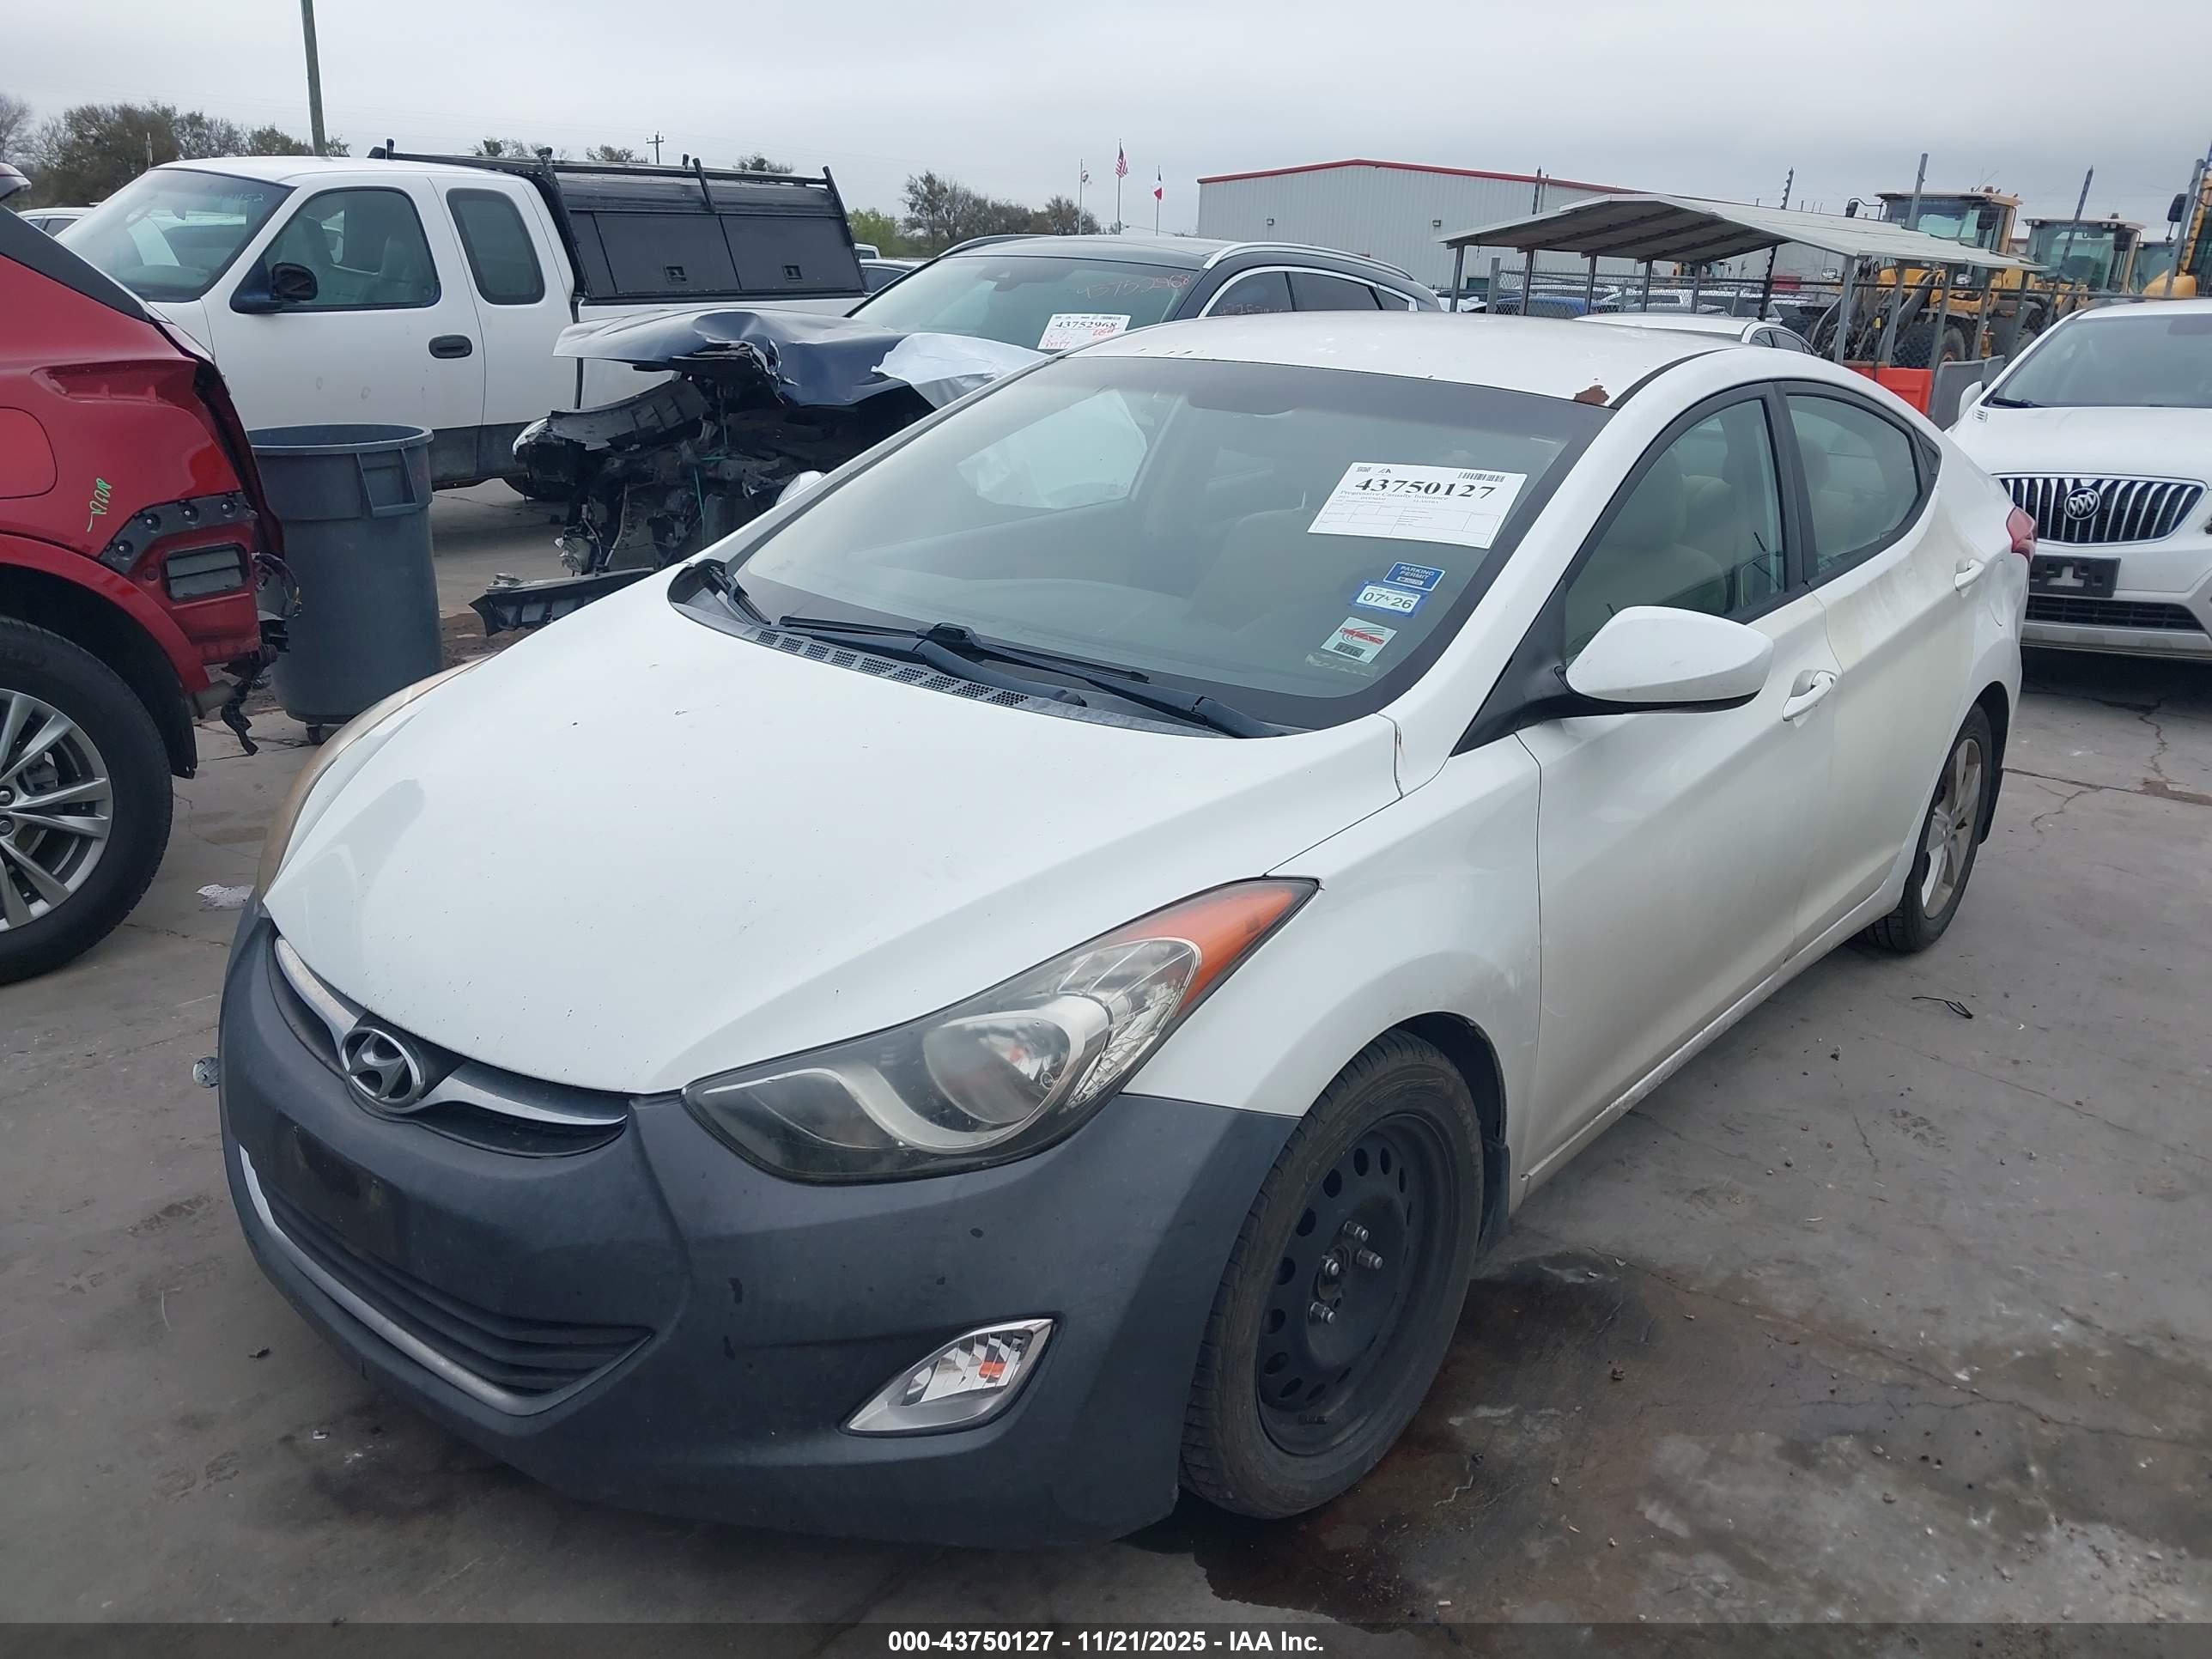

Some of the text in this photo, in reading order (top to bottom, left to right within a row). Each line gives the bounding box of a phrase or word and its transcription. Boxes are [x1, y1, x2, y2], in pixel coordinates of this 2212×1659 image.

[1355, 477, 1497, 499] 43750127
[1400, 565, 1435, 576] PARKING
[1400, 571, 1431, 580] PERMIT
[1363, 592, 1386, 603] 07
[1390, 597, 1413, 609] 26
